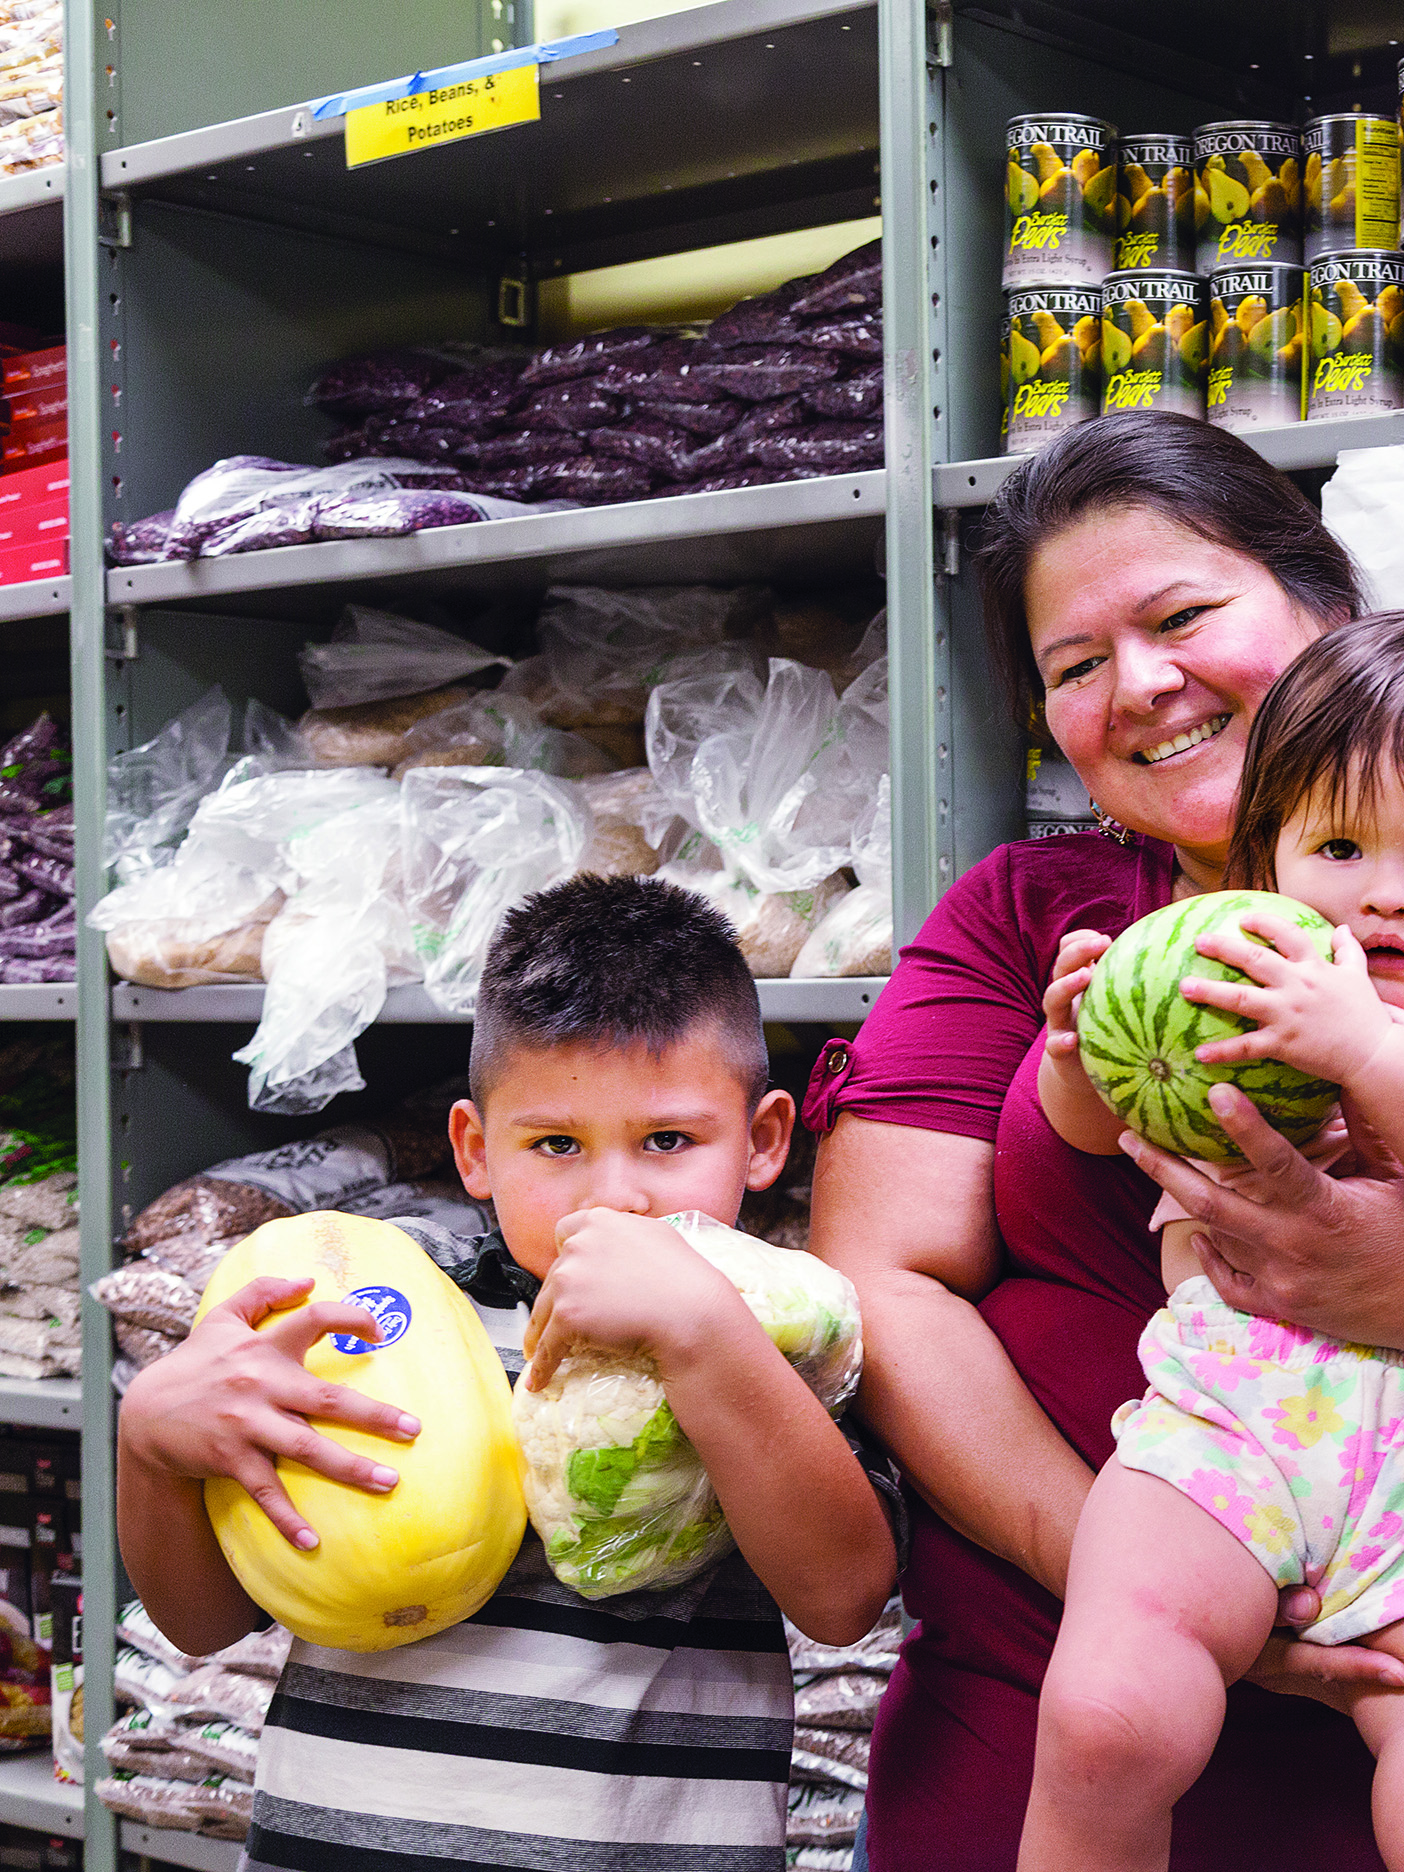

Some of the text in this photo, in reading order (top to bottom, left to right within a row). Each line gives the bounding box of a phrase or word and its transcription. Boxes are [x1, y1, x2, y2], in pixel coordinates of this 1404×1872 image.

[385, 75, 496, 116] Rice, Beans, &
[408, 114, 474, 143] Potatoes
[1049, 125, 1105, 147] TRAIL
[1032, 212, 1069, 227] Bartlett
[1010, 216, 1067, 255] Pears
[1125, 231, 1160, 246] Bartlett
[1216, 225, 1278, 262] Pears
[1142, 281, 1200, 302] TRAIL
[1221, 274, 1273, 294] TRAIL
[1335, 352, 1373, 367] Bartlett
[1125, 369, 1163, 384] Bartlett
[1312, 358, 1372, 398] Pears
[1032, 380, 1070, 395] Bartlett
[1104, 373, 1161, 414] Pears
[1012, 384, 1070, 423] Pears
[1325, 395, 1393, 409] Extra Light Syrup
